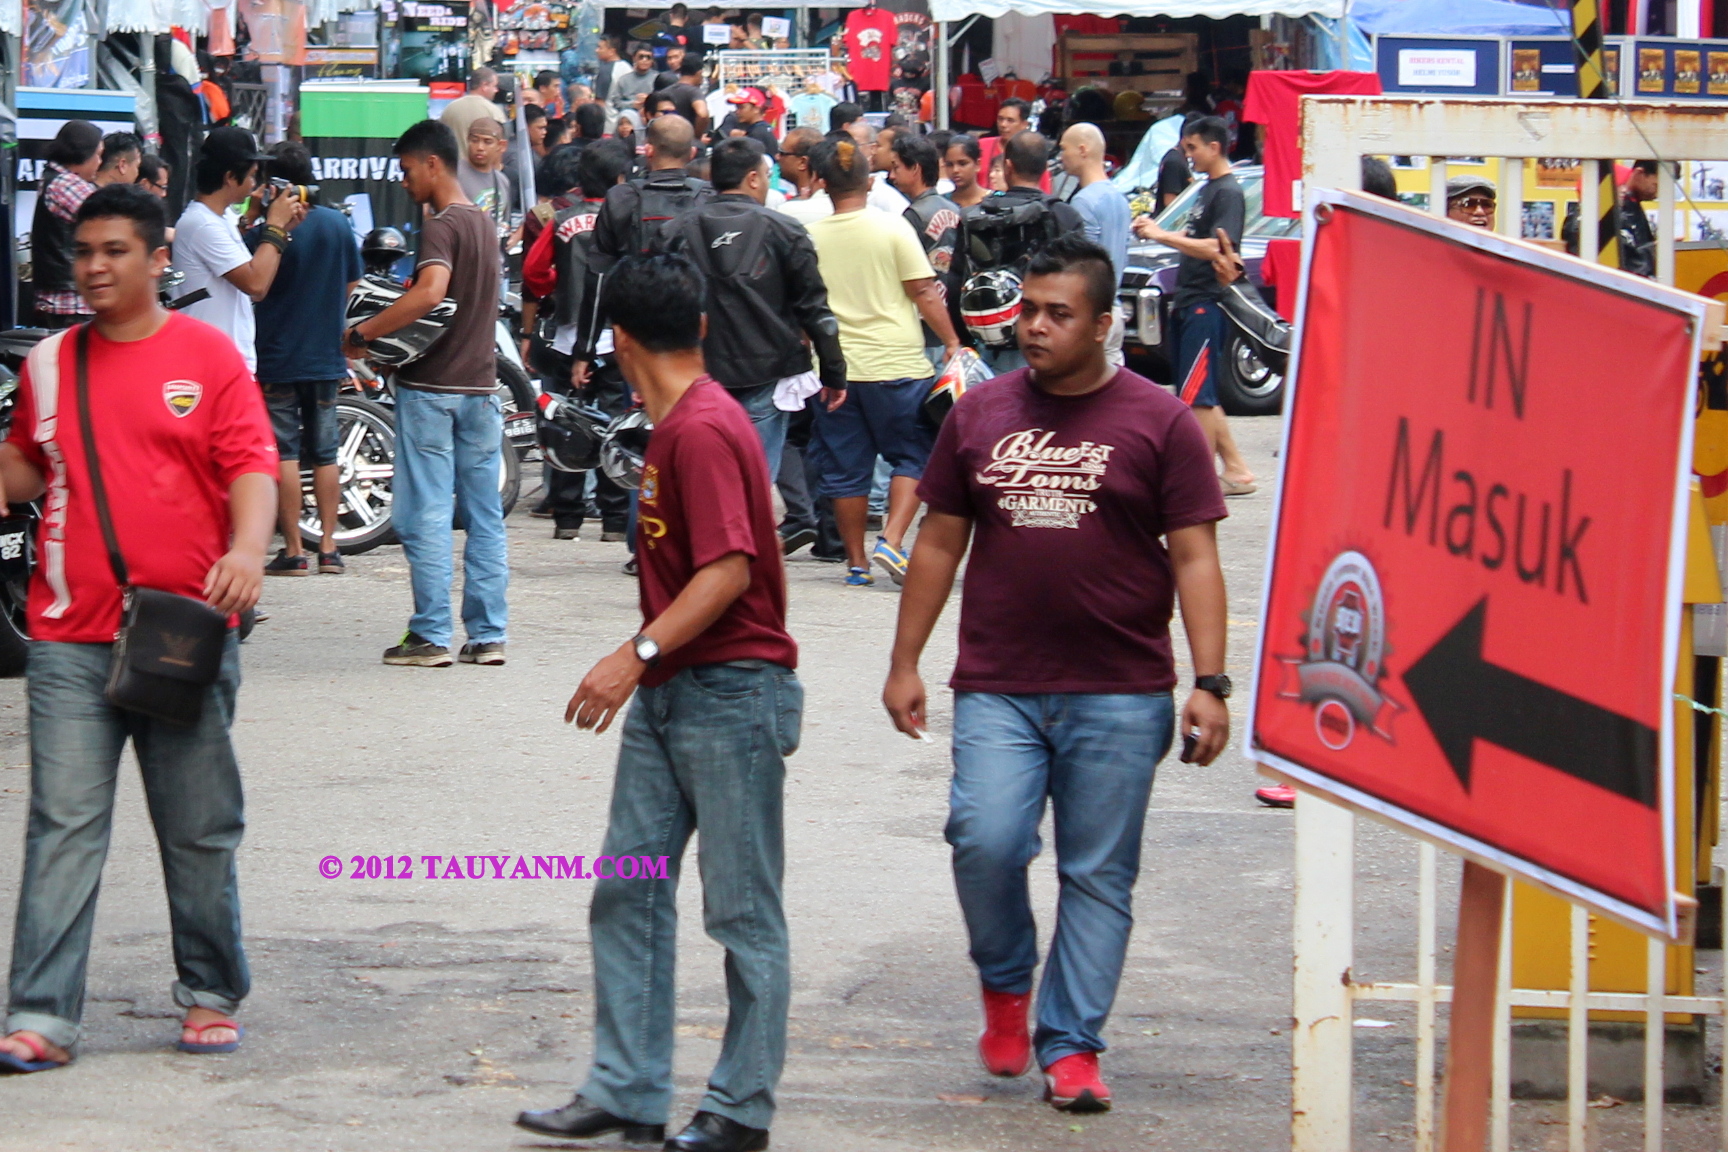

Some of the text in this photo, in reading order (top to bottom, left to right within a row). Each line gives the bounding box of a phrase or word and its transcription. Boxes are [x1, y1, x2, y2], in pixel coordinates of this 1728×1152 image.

[403, 2, 446, 17] NEED
[429, 17, 468, 27] RIDE
[310, 156, 404, 182] ARRIVA
[1467, 285, 1534, 421] IN
[991, 428, 1082, 465] Blue
[1003, 494, 1089, 514] GARMENT
[1383, 415, 1593, 606] Masuk
[1, 544, 22, 560] 82
